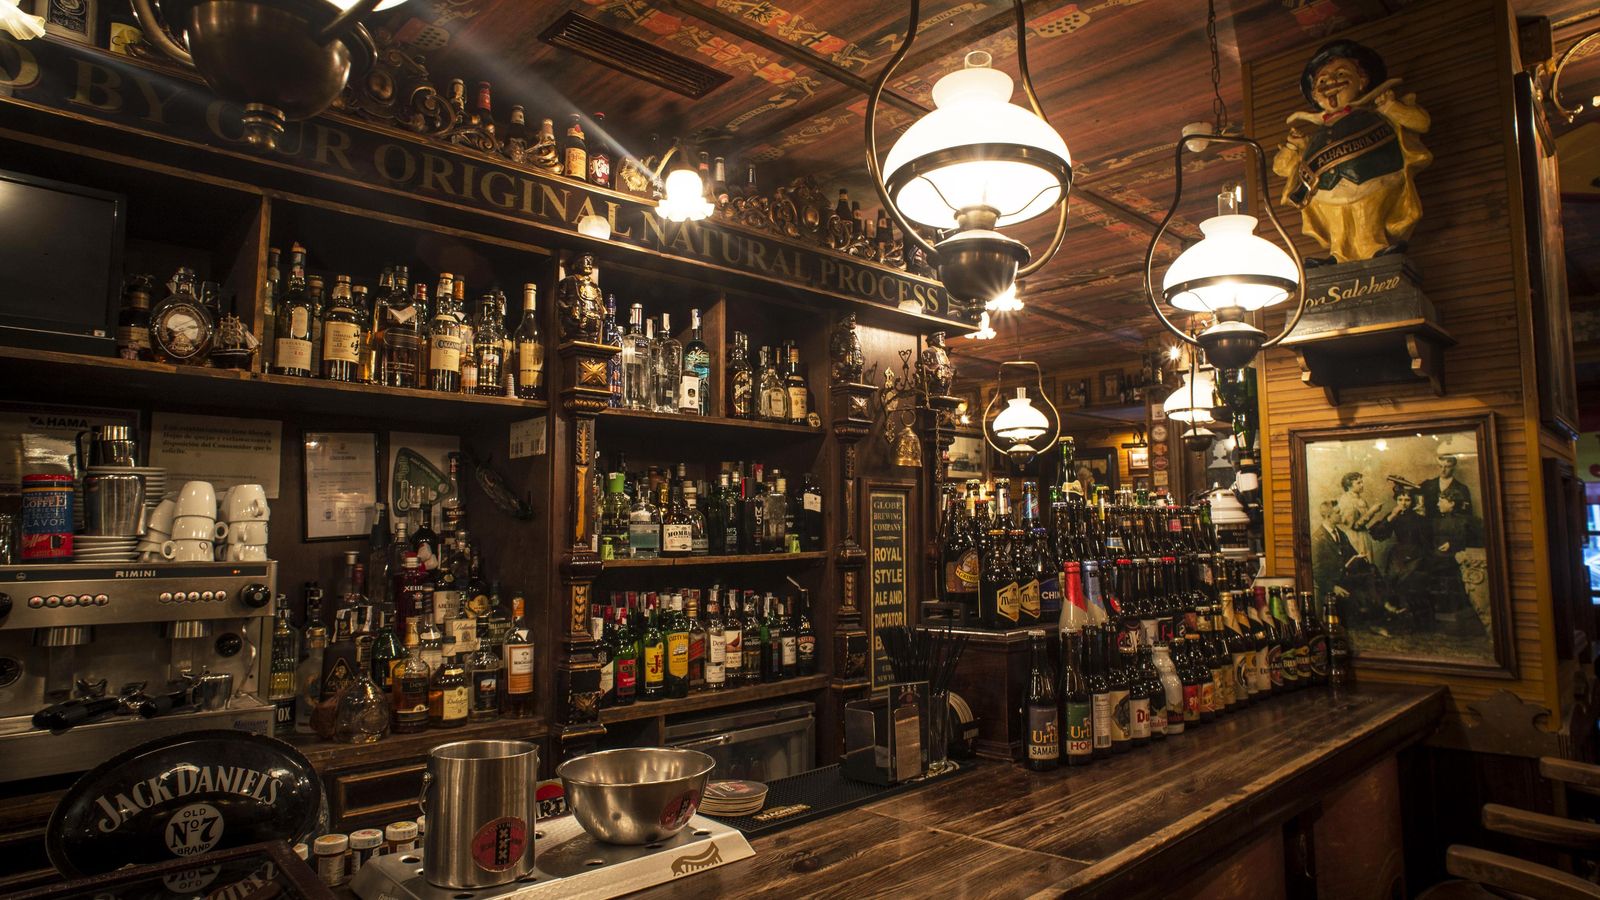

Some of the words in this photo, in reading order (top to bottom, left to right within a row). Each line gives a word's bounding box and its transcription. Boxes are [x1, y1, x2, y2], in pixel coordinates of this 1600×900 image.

[1317, 136, 1374, 167] ALHAMBRA
[64, 56, 190, 124] BY
[374, 142, 631, 237] ORIGINAL
[641, 209, 811, 283] NATURAL
[820, 257, 940, 313] PROCESS
[873, 501, 902, 510] GLOBE
[873, 512, 902, 520] BREWING
[873, 523, 902, 532] COMPANY
[874, 547, 902, 562] ROYAL
[115, 570, 156, 578] RIMINI
[874, 569, 903, 584] STYLE
[875, 591, 888, 607] ALE
[889, 590, 903, 605] AND
[874, 611, 903, 628] DICTATOR
[95, 773, 175, 833] JACK
[183, 807, 206, 818] OLD
[178, 843, 210, 856] BRAND
